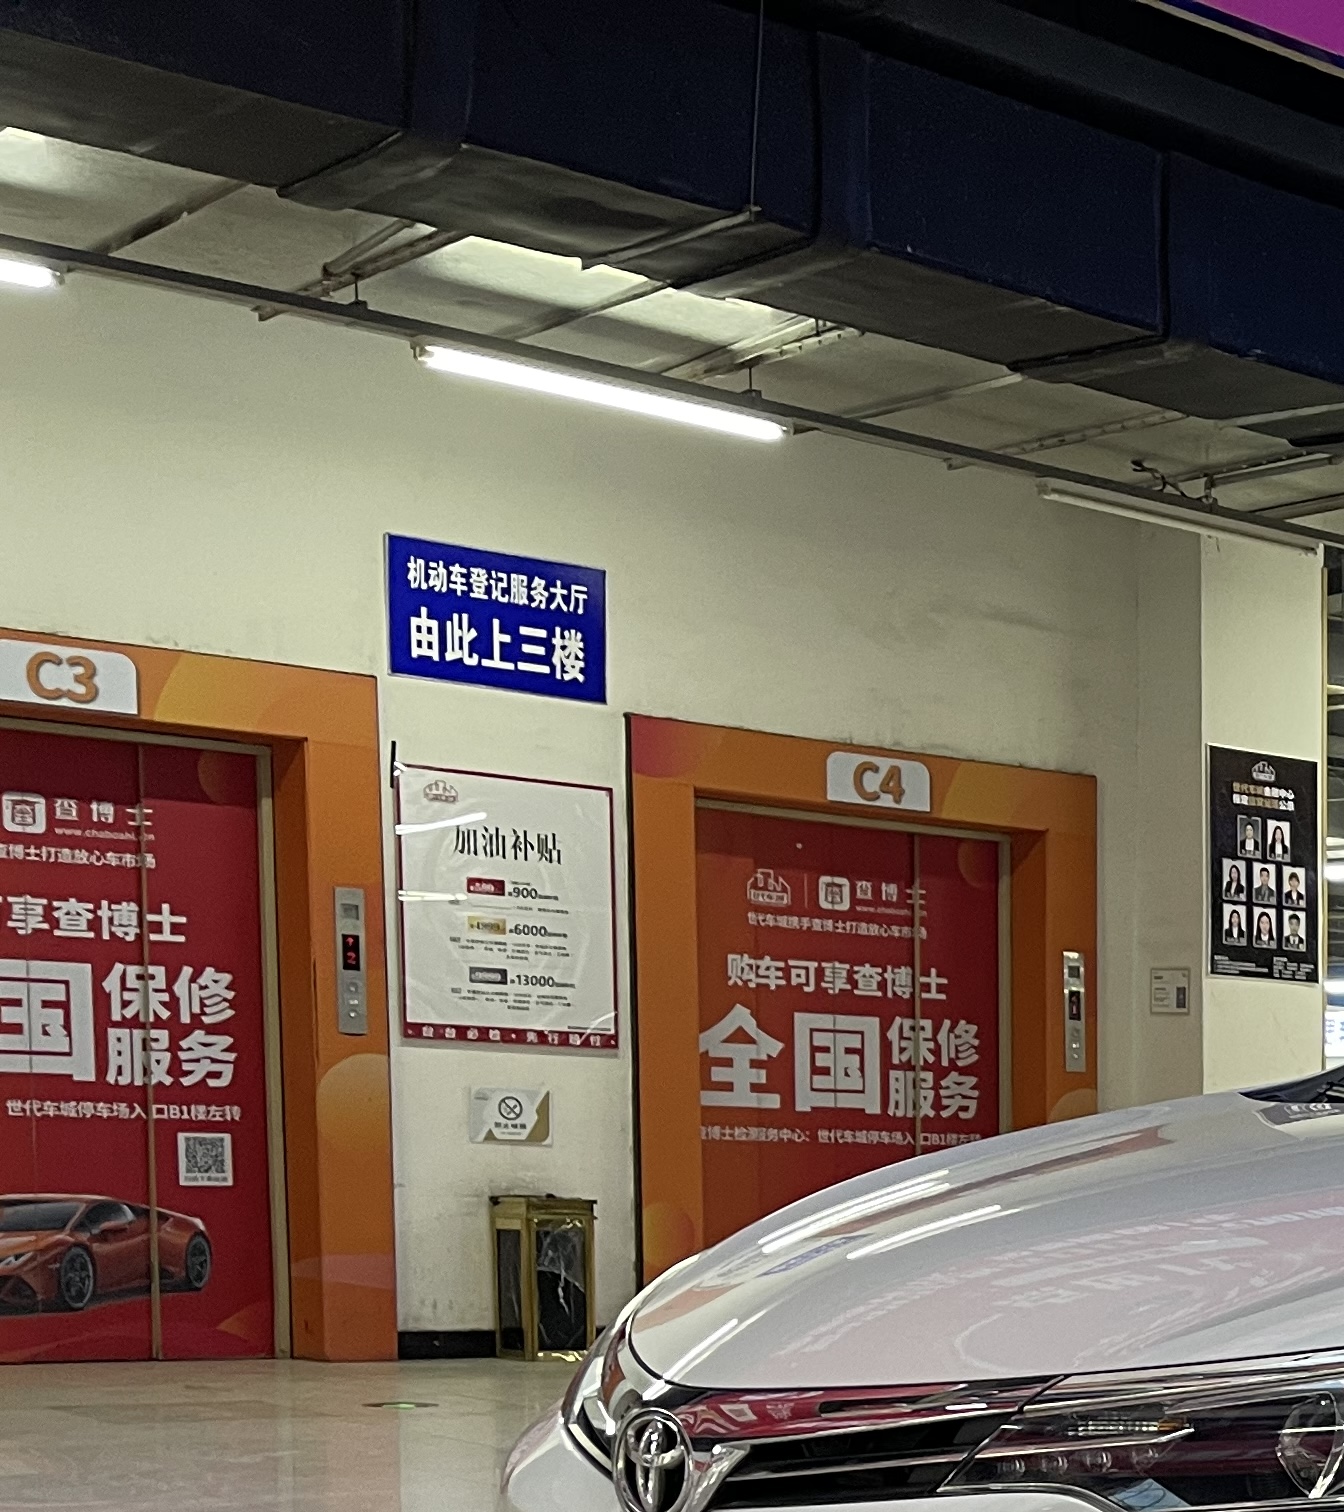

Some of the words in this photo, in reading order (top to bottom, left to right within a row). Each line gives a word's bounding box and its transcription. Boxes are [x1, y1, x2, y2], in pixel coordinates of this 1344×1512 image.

[407, 555, 588, 614] 机动车登记服务大厅
[410, 607, 586, 684] 由此上三楼
[26, 651, 99, 703] C3
[854, 762, 905, 804] C4
[453, 825, 562, 865] 加油补贴
[0, 894, 187, 943] 享查博士
[102, 962, 236, 1025] 保修
[727, 953, 948, 1000] 购车可享查博士
[106, 1027, 238, 1088] 服务
[699, 1003, 881, 1115] 全国
[887, 1015, 980, 1068] 保修
[887, 1069, 980, 1120] 服务
